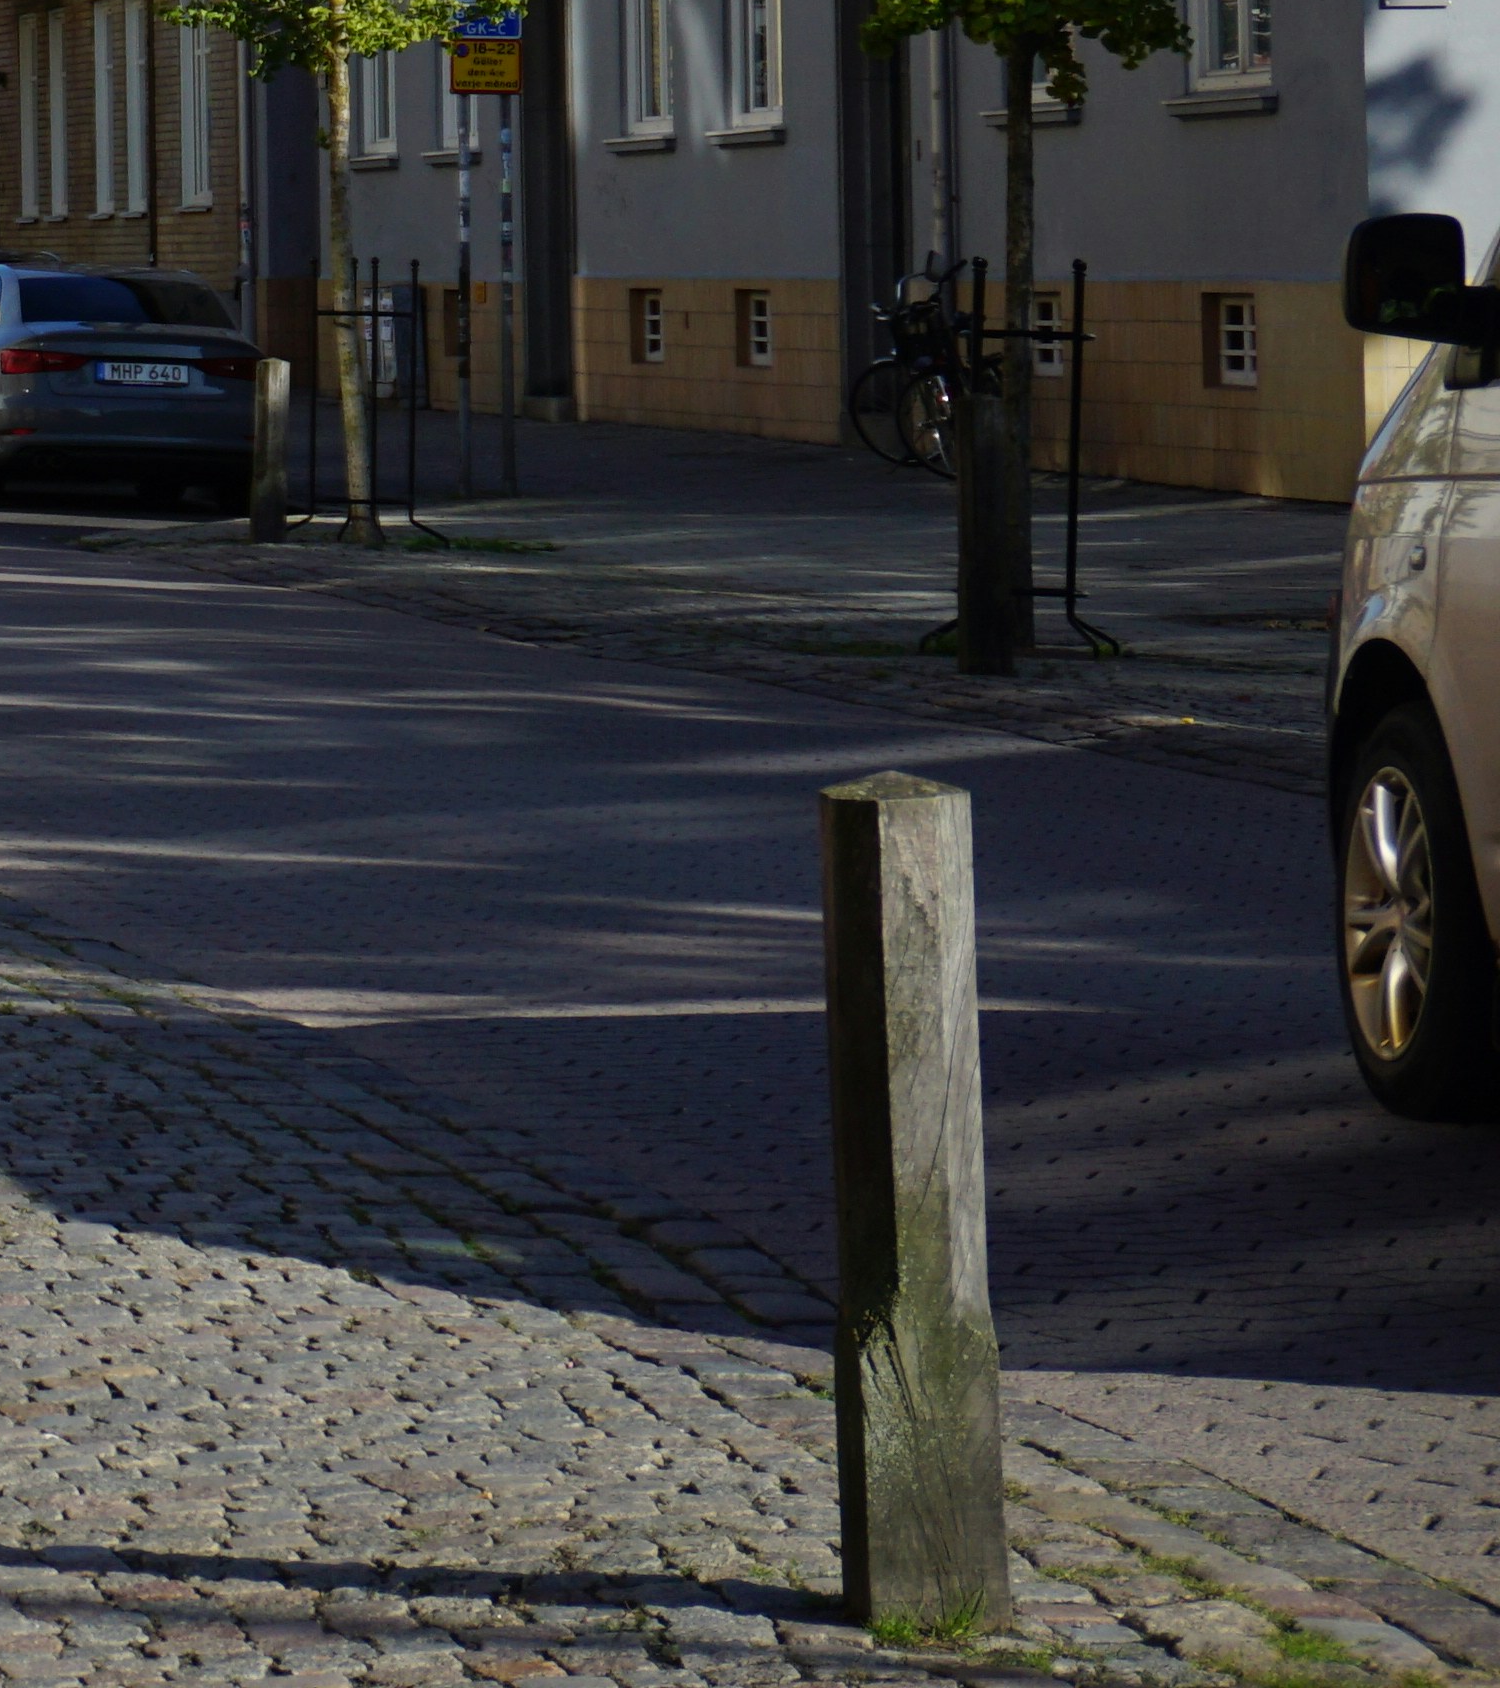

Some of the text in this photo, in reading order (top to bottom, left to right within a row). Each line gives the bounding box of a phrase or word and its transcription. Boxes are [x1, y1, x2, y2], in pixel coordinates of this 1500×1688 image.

[466, 23, 507, 35] GK-C
[110, 364, 182, 381] MHP 640
